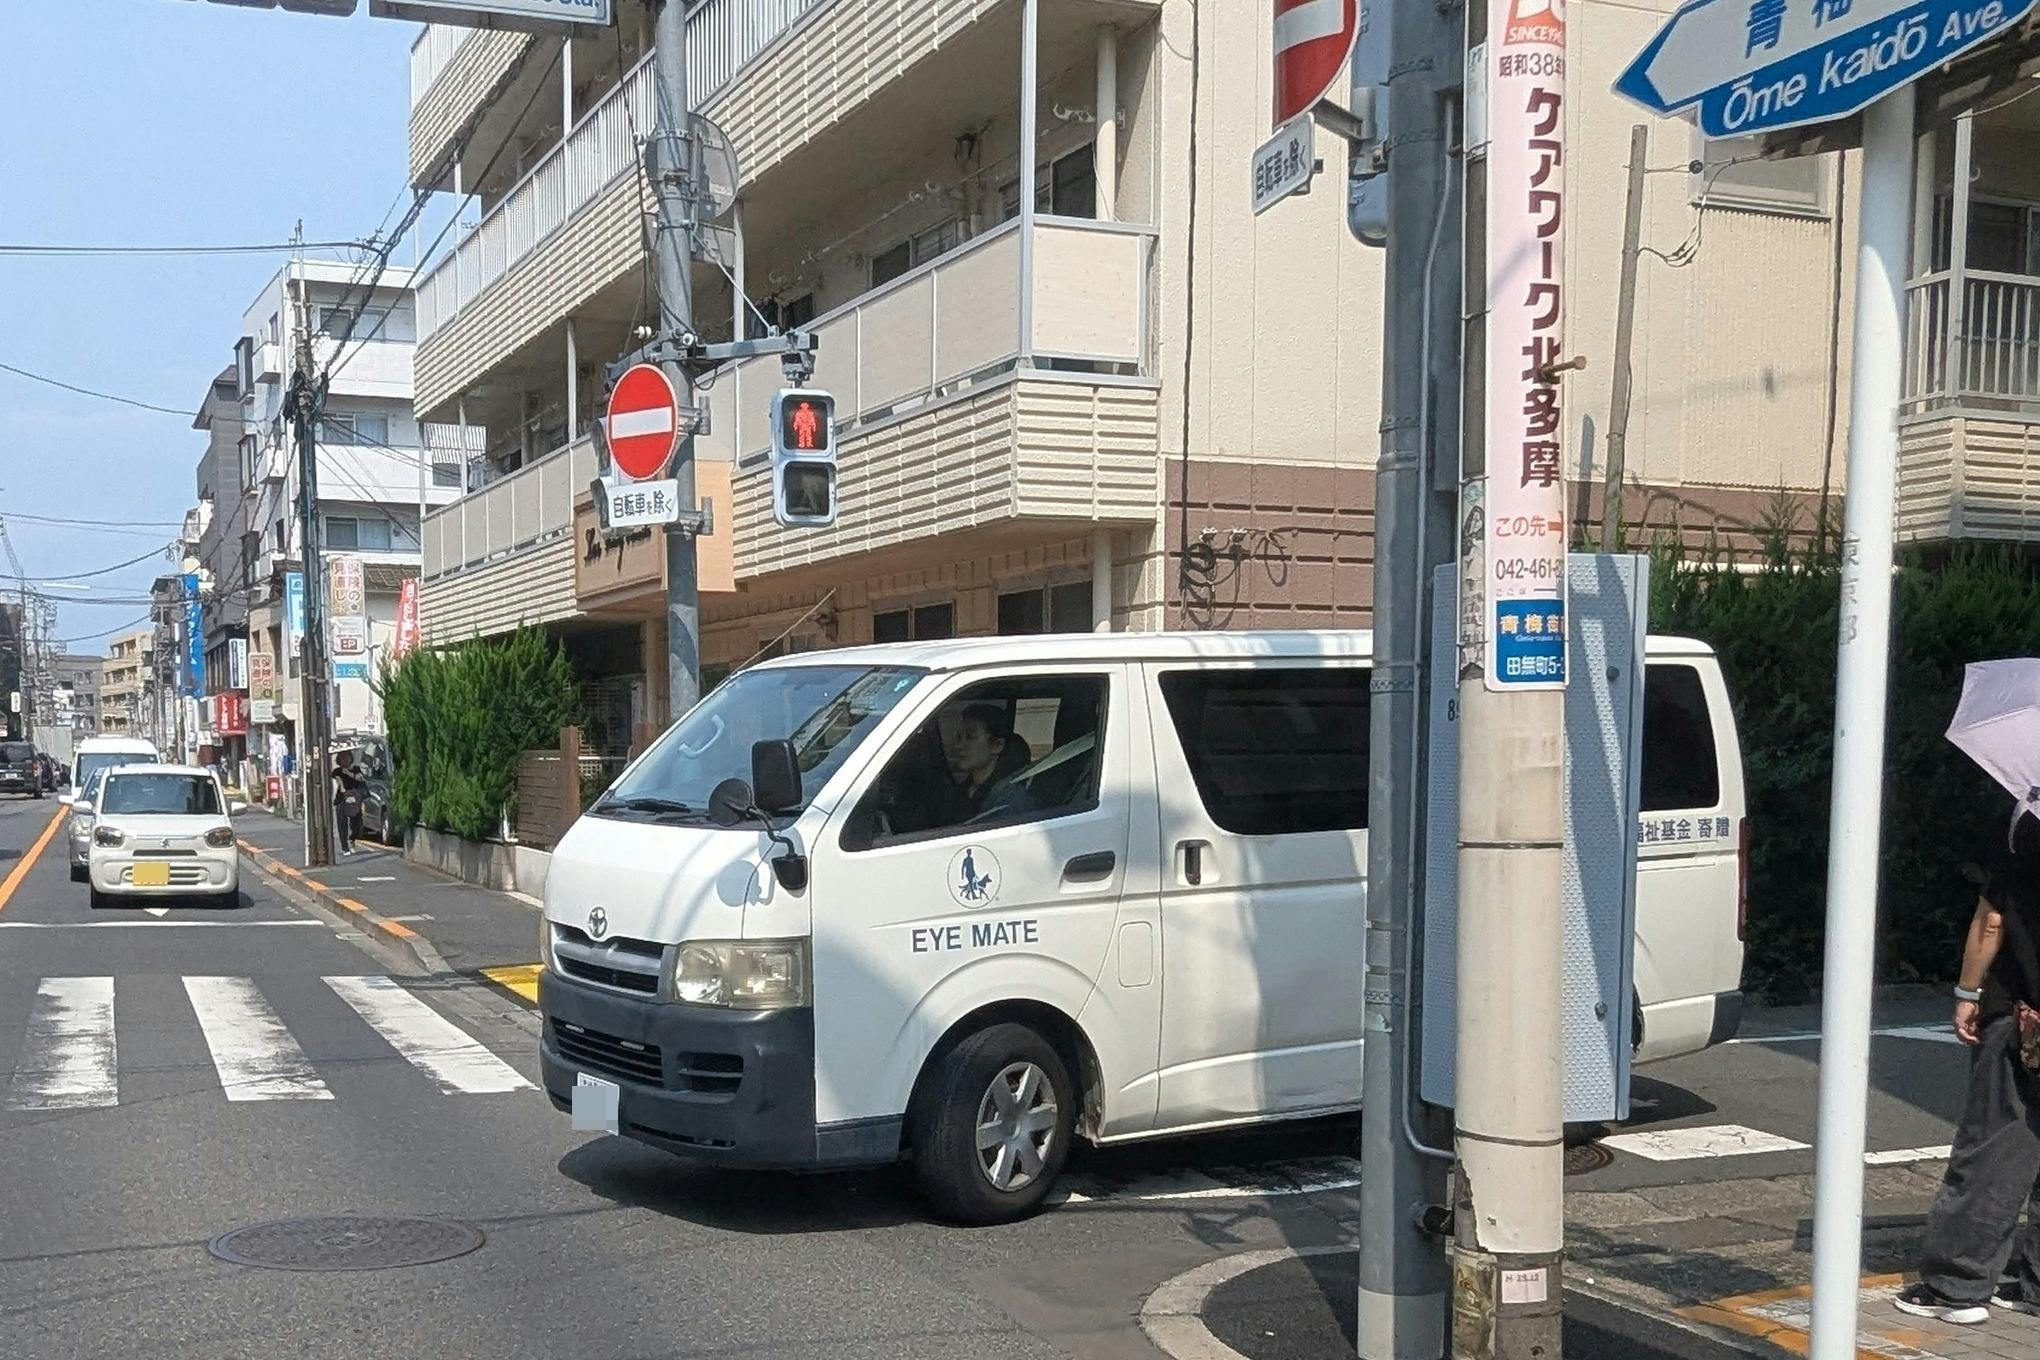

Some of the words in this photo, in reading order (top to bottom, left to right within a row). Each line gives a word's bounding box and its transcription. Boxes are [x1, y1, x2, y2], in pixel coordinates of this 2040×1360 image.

[1521, 87, 1562, 488] ケアワーク北多摩
[613, 490, 673, 518] 自転車を除く
[1496, 515, 1546, 538] この先
[912, 926, 962, 953] EYE
[972, 919, 1039, 947] MATE
